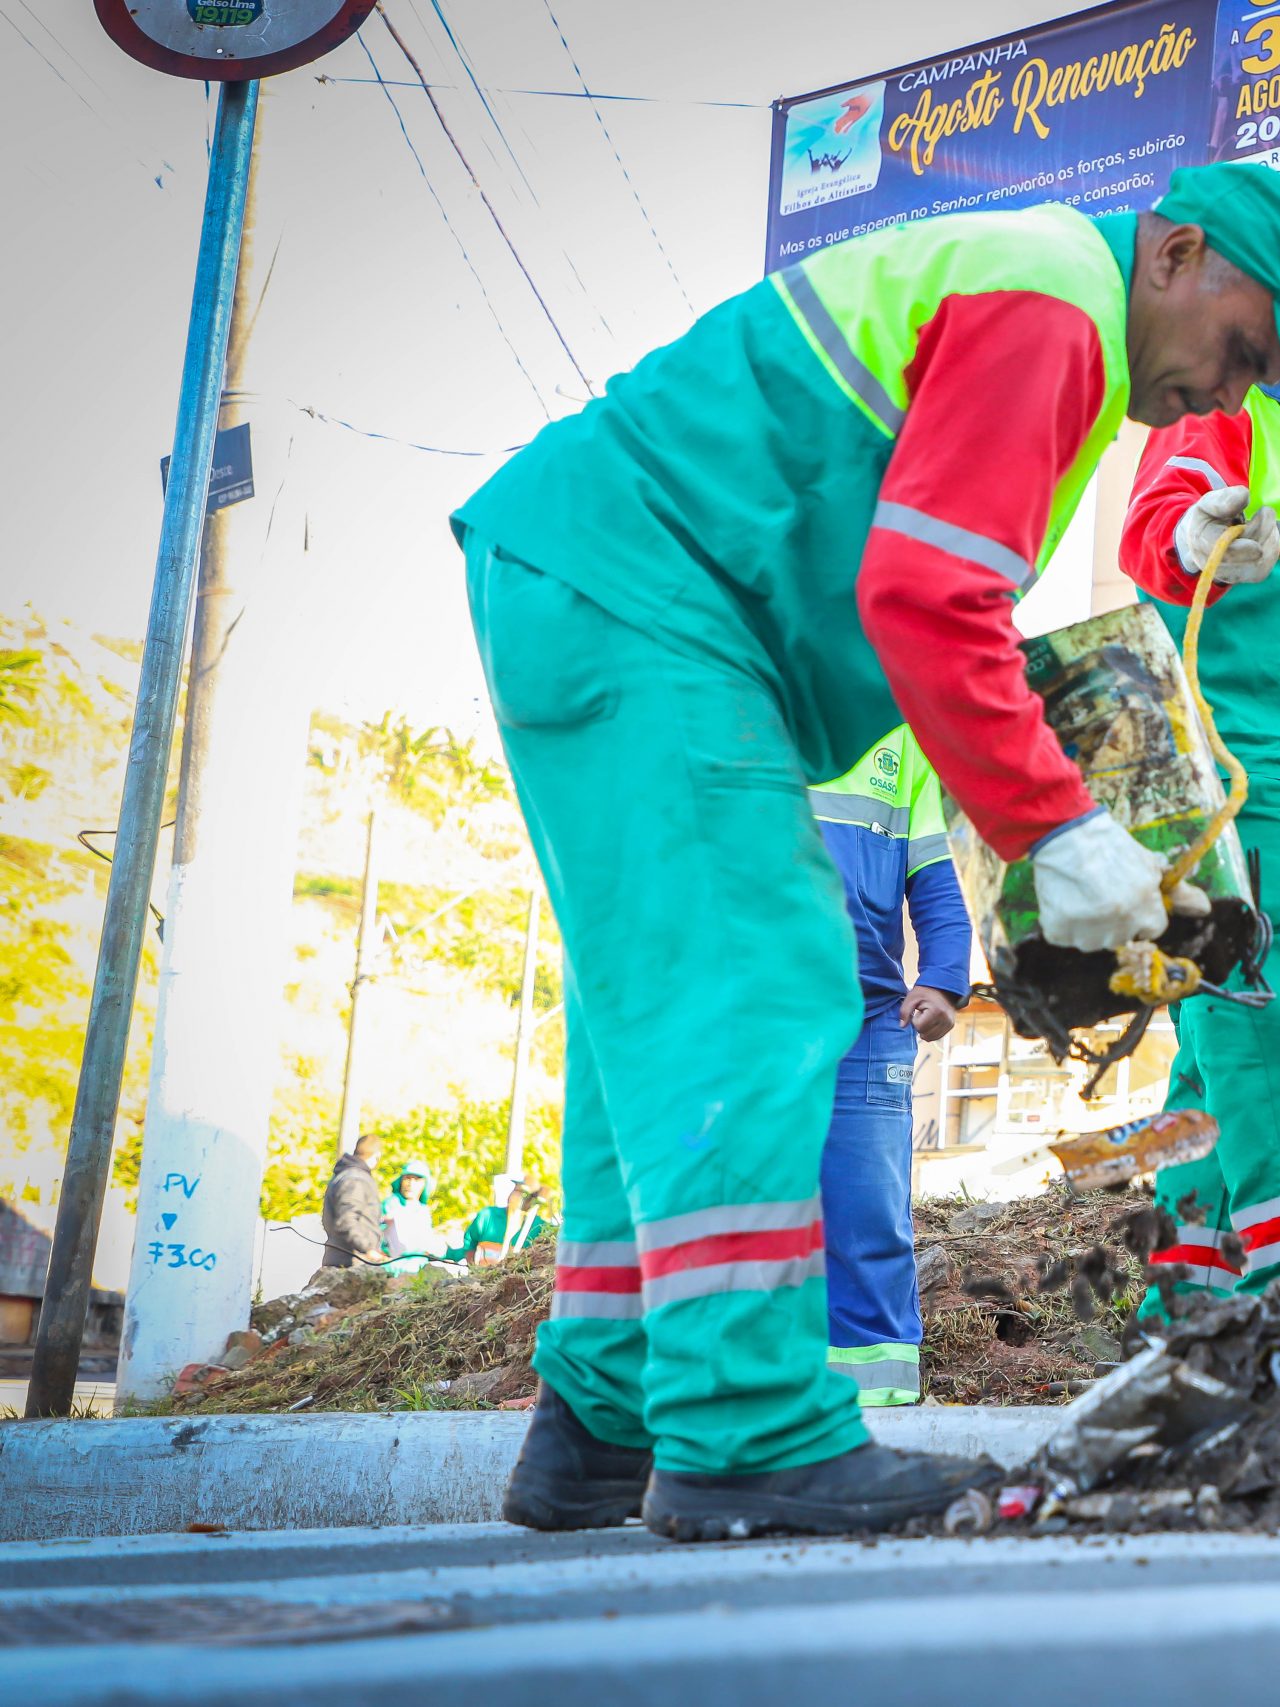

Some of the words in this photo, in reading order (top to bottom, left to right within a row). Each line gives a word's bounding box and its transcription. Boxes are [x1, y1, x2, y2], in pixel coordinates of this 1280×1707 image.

[195, 6, 253, 24] 19.119
[1230, 30, 1240, 45] A
[898, 39, 1028, 92] CAMPANHA
[888, 69, 1004, 176] Agosto
[1011, 22, 1197, 140] Renovação
[779, 240, 804, 257] Mas
[825, 228, 849, 246] que
[852, 211, 908, 236] esperam
[910, 206, 928, 220] no
[931, 192, 984, 216] Senhor
[985, 172, 1055, 203] renovarão
[1077, 151, 1126, 174] forças,
[1128, 133, 1186, 160] subirão
[1083, 171, 1155, 202] cansarão;
[783, 200, 812, 214] Filhos
